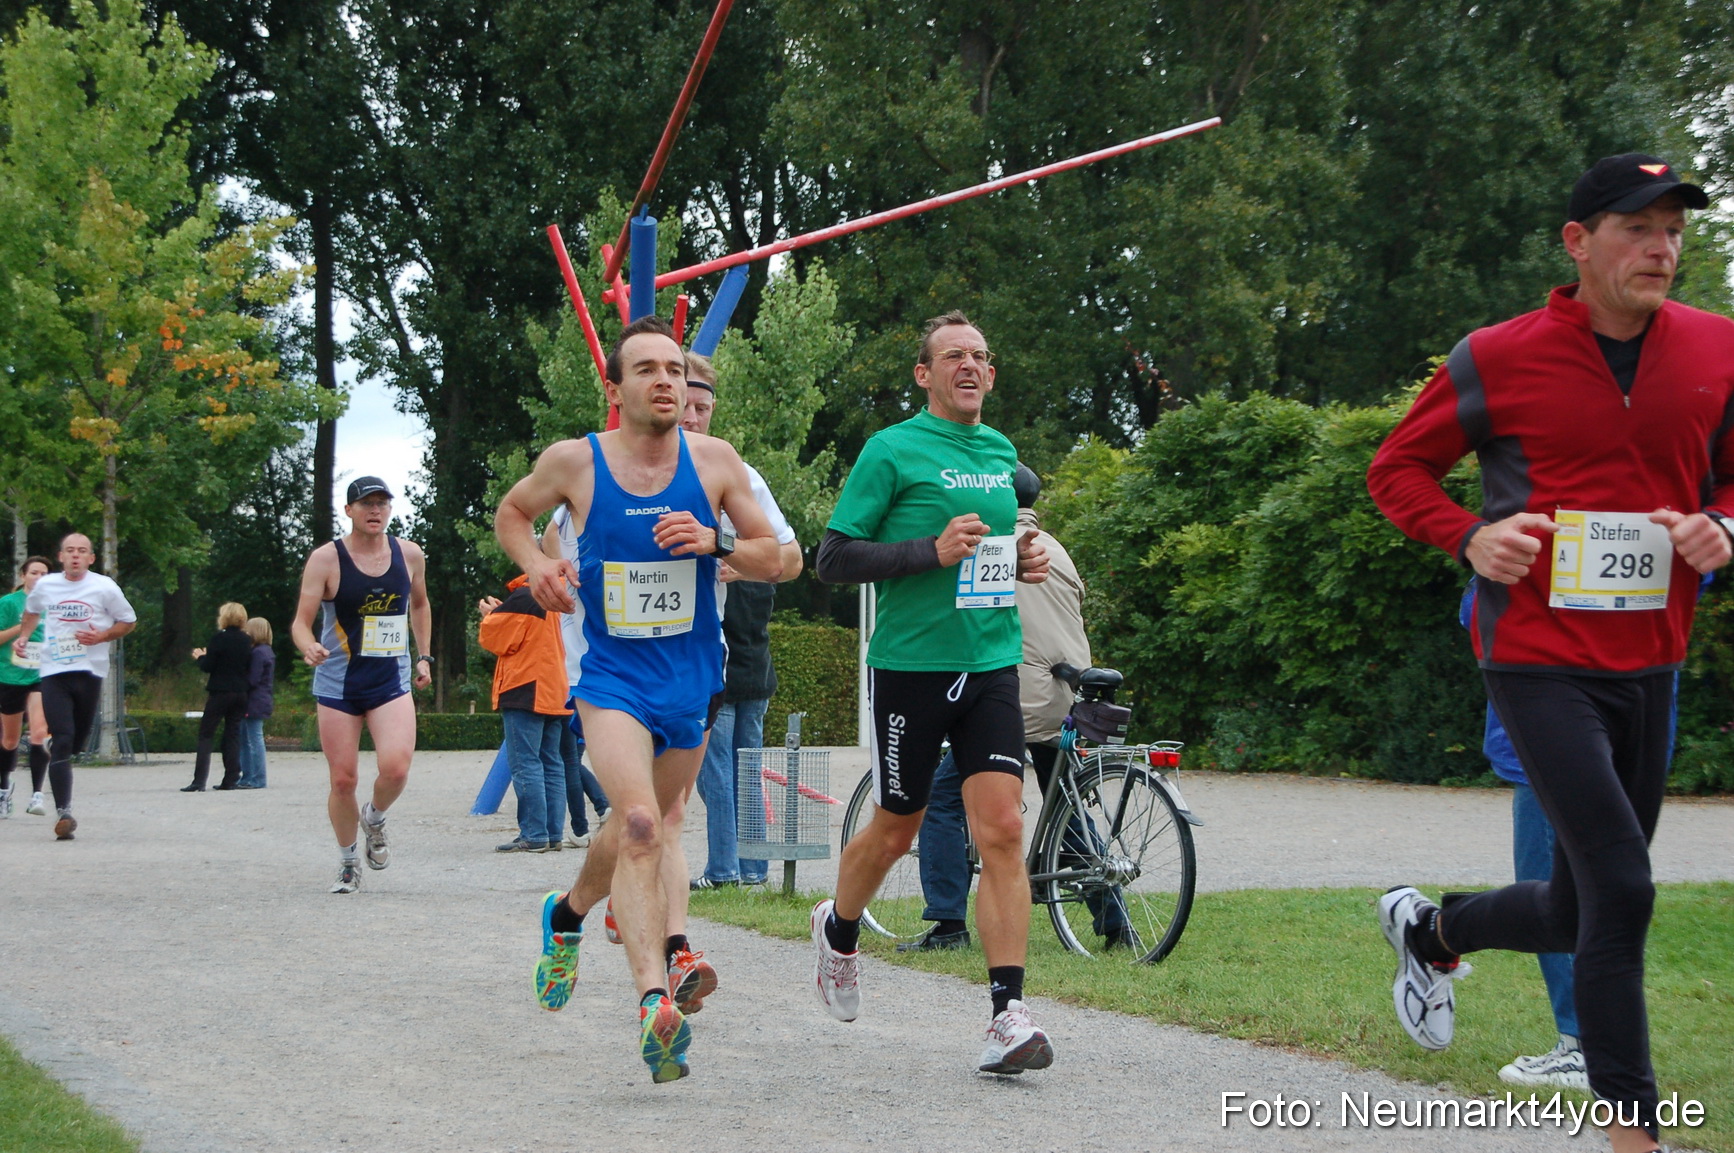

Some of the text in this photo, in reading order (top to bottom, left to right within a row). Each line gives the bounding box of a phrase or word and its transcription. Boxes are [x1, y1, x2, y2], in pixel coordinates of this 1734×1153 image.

[940, 468, 1011, 494] Sinupret
[625, 505, 671, 515] DIADORA
[1590, 522, 1641, 541] Stefan
[981, 544, 1004, 556] Peter
[1559, 549, 1567, 563] A
[980, 563, 1015, 582] 2234
[1599, 552, 1655, 579] 298
[629, 570, 668, 584] Martin
[608, 591, 615, 602] A
[639, 591, 682, 613] 743
[382, 632, 400, 643] 718
[60, 644, 83, 654] 3415
[885, 713, 906, 798] Sinupret
